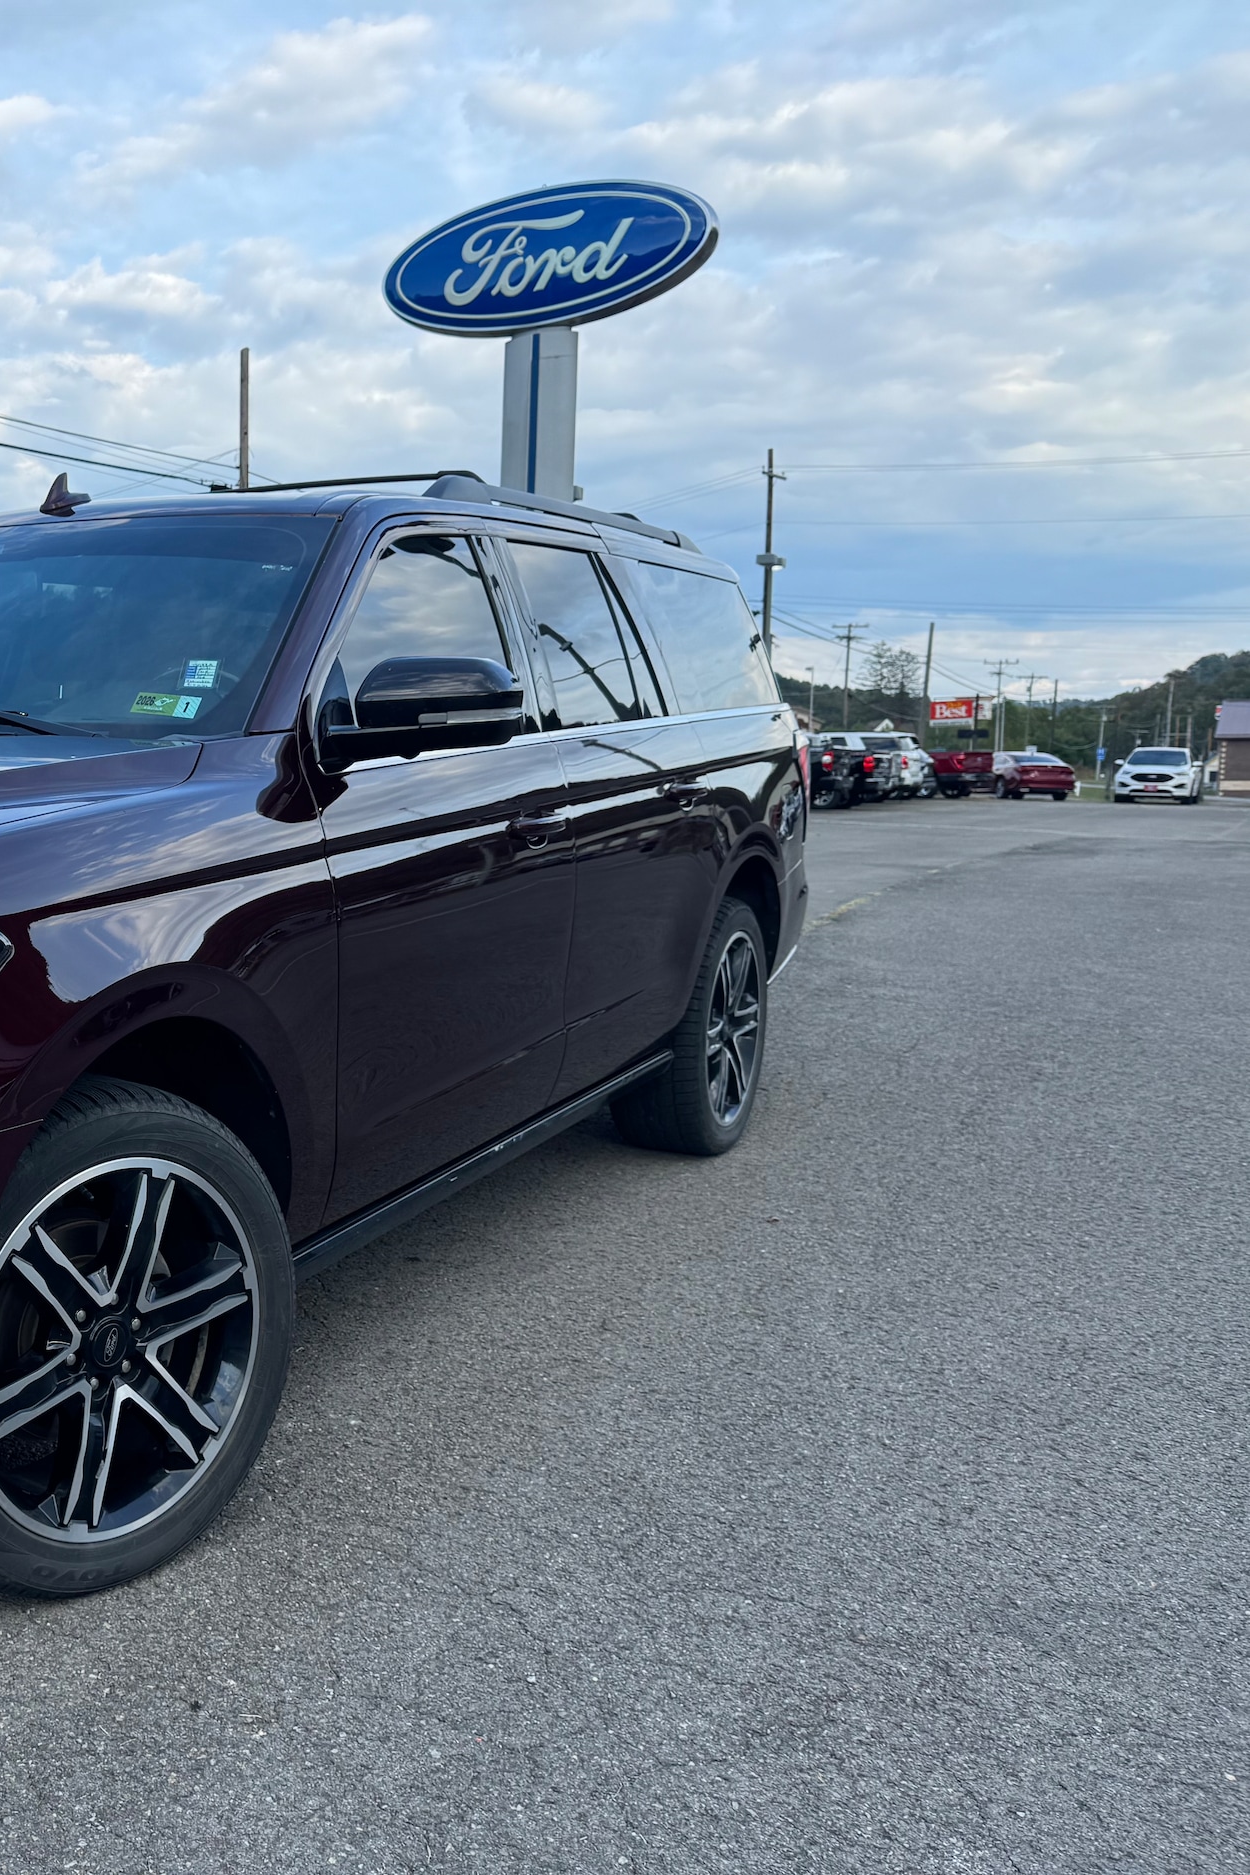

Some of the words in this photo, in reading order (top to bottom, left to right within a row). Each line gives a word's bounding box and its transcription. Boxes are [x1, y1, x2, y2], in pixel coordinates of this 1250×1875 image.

[443, 209, 635, 307] Ford
[136, 695, 156, 706] 2026
[183, 701, 190, 713] 1
[935, 703, 967, 719] Best
[30, 1562, 129, 1582] TOYO
